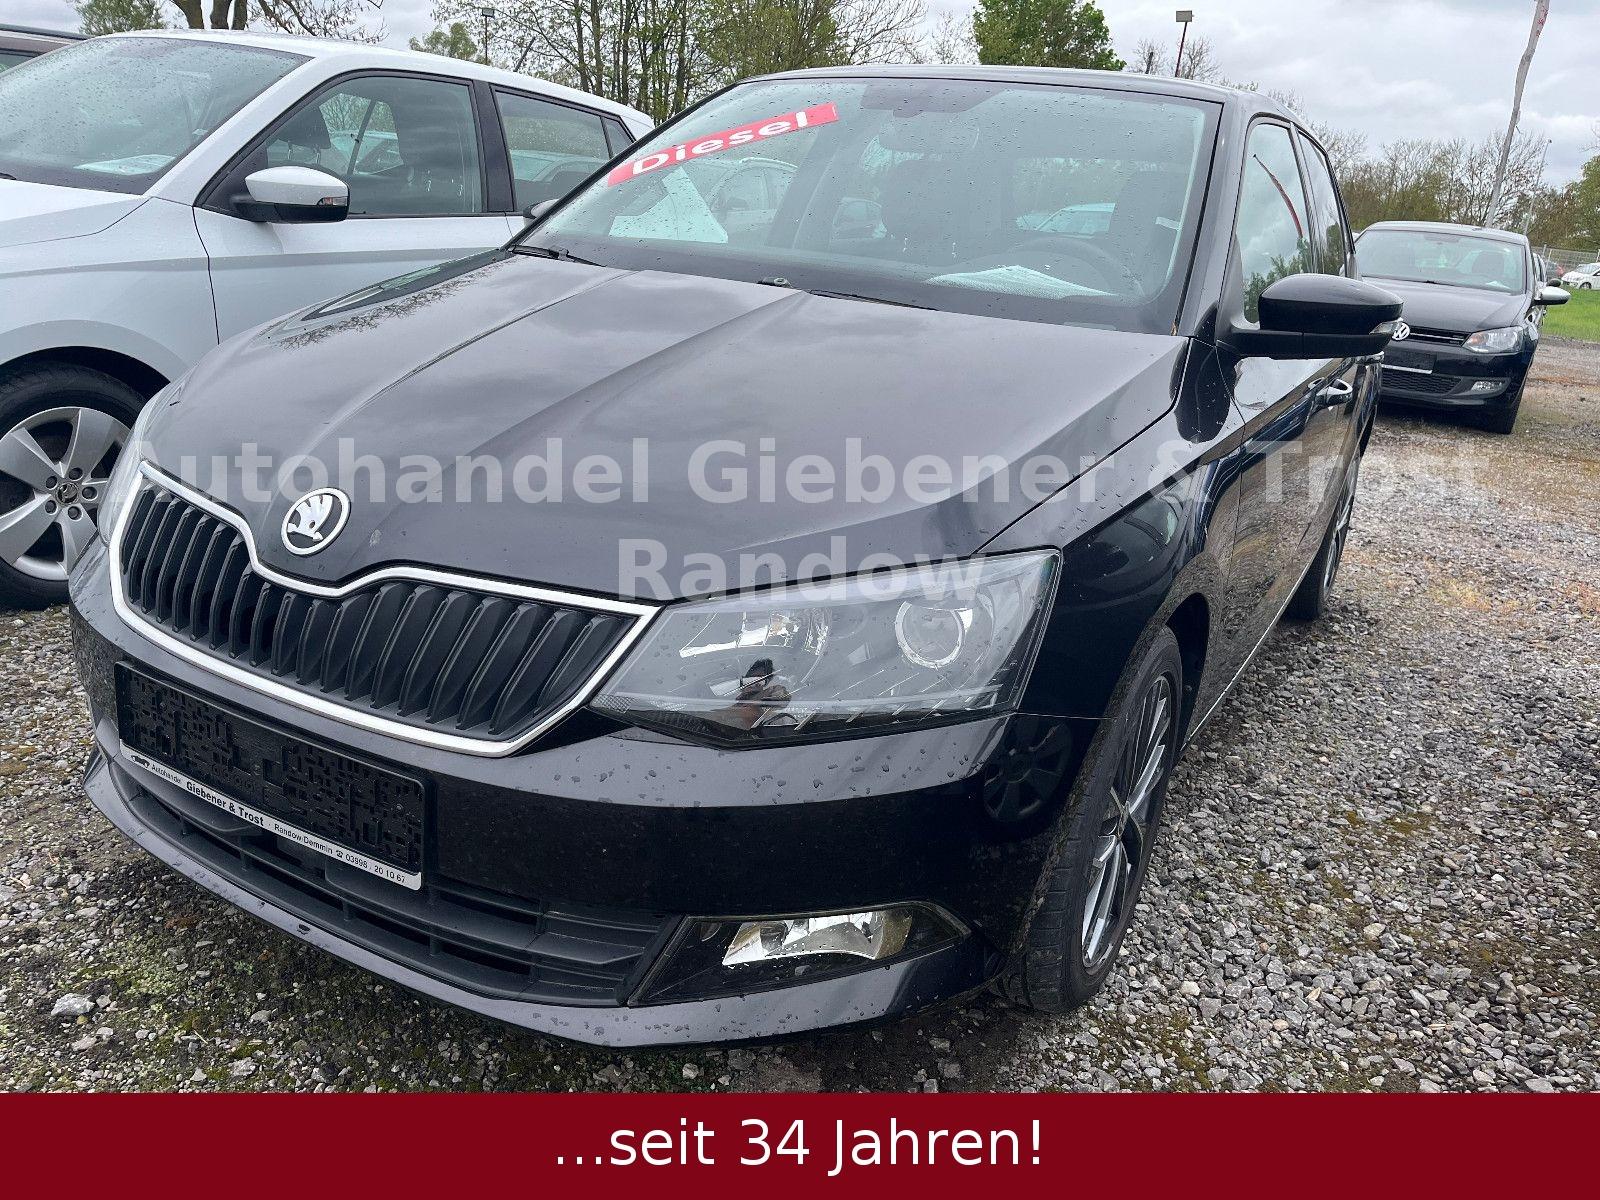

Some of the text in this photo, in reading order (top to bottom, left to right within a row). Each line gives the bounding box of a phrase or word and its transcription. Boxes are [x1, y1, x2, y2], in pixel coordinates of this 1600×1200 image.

[632, 111, 808, 175] Diesel
[186, 781, 227, 808] Giebener
[229, 802, 236, 815] &
[239, 806, 264, 826] Trost
